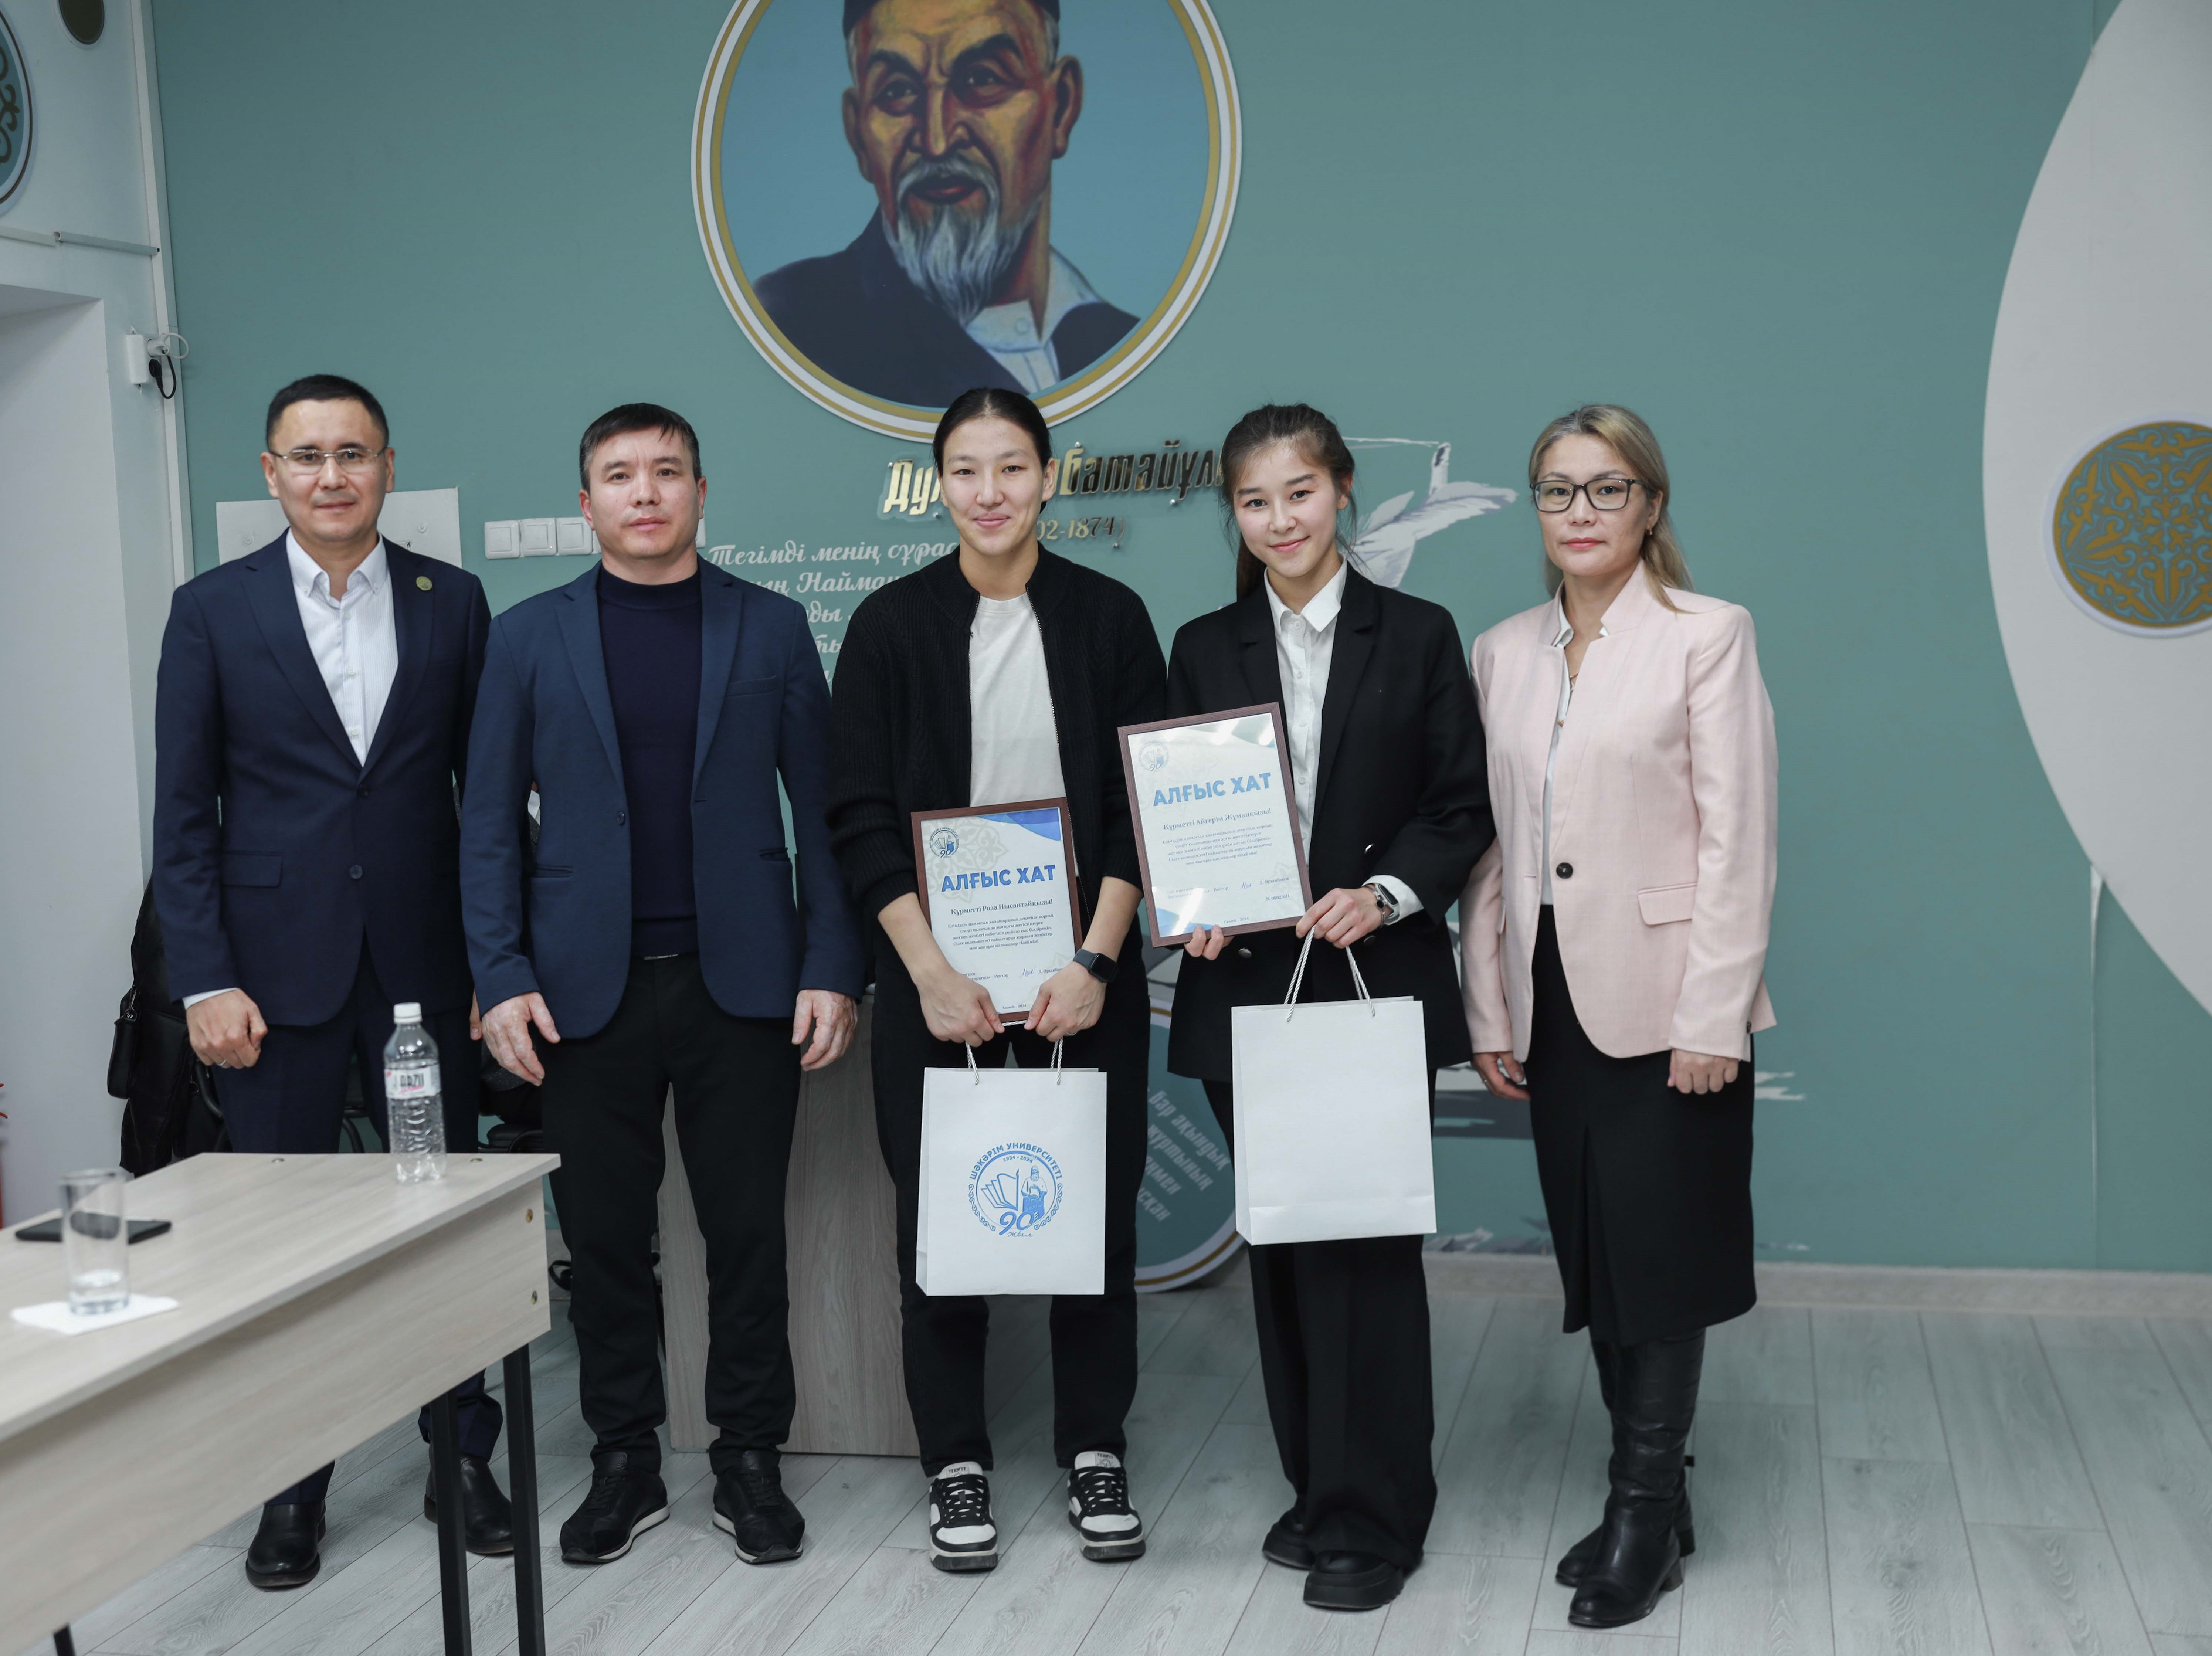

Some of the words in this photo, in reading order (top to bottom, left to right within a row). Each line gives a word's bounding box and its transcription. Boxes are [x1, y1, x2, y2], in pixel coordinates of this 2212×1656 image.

[1037, 516, 1124, 543] 02-1874)
[708, 540, 806, 566] Тегімді
[811, 542, 882, 566] менің
[1153, 780, 1226, 807] АЛҒЫС
[1231, 773, 1271, 794] ХАТ
[1196, 816, 1223, 825] Айгерім
[940, 849, 951, 858] 90
[941, 869, 1012, 892] АЛҒЫС
[1016, 864, 1056, 884] ХАТ
[1148, 1090, 1177, 1117] бар
[1171, 1114, 1231, 1171] ақындық
[969, 1144, 1004, 1180] ШӘКӘРІМ
[1006, 1142, 1063, 1180] УНИВЕРСИТЕТІ
[999, 1211, 1035, 1235] 90
